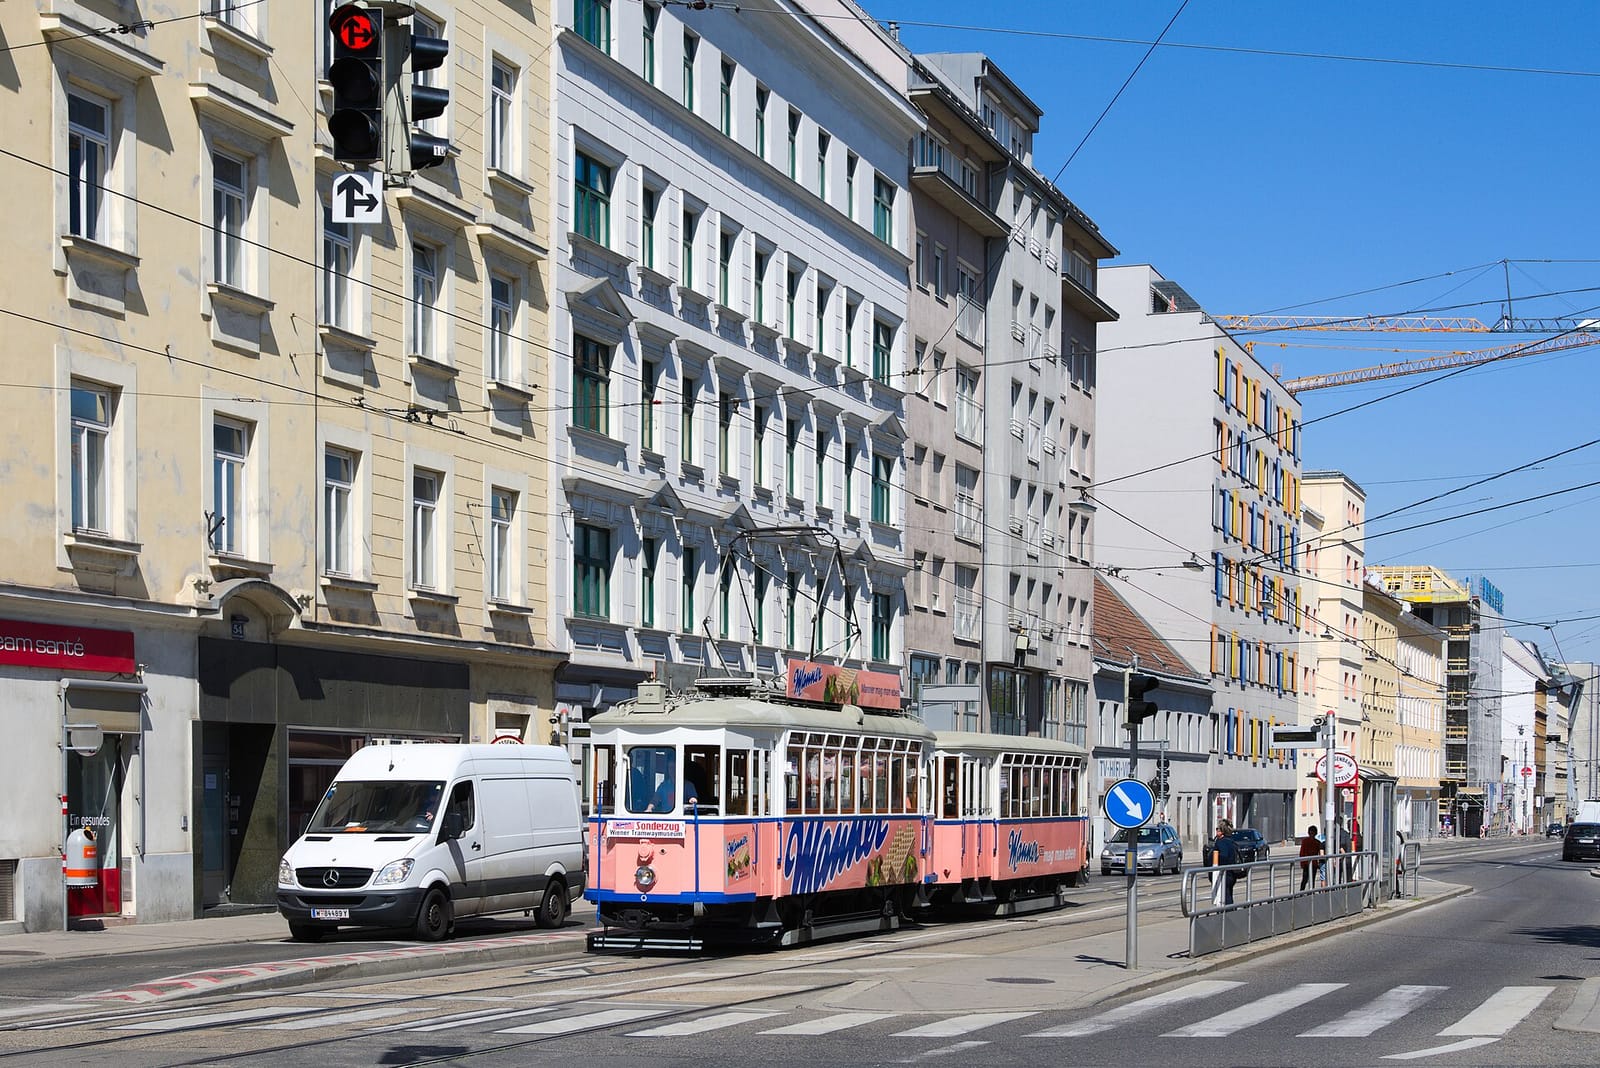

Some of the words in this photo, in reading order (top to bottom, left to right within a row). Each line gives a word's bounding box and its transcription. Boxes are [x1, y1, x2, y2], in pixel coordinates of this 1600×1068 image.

[435, 146, 446, 156] 10
[36, 637, 85, 657] santé
[793, 665, 823, 698] Manner
[70, 813, 80, 826] Ein
[81, 815, 110, 829] gesundes
[636, 821, 680, 832] Sonderzug
[631, 829, 683, 838] Tramwaymuseum
[783, 820, 890, 895] Manner
[1008, 827, 1040, 874] Manner
